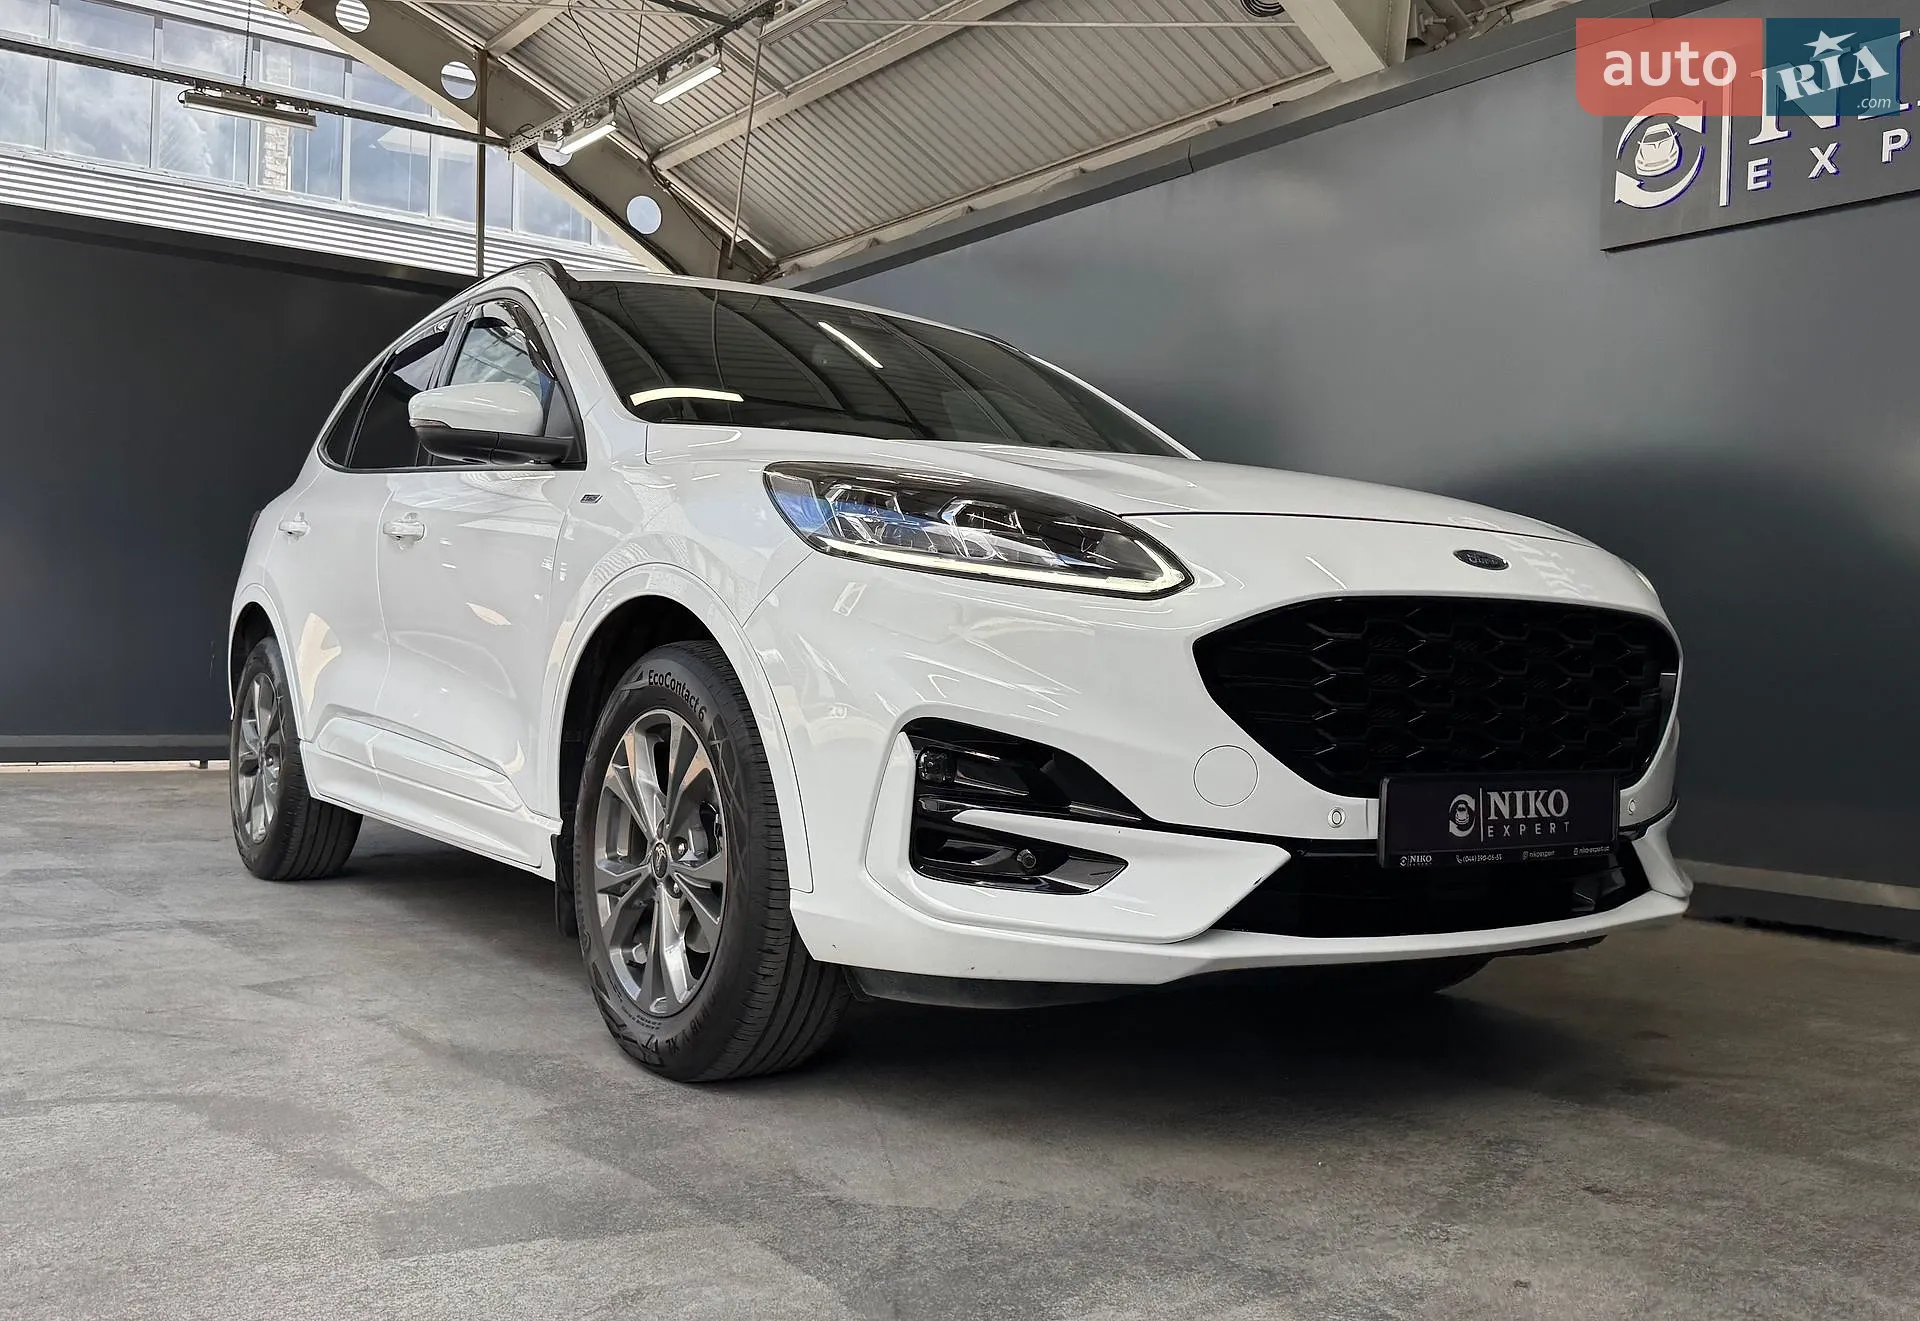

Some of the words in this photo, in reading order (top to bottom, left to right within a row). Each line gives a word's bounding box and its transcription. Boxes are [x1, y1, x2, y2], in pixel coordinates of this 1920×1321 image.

[1748, 28, 1920, 145] NI
[649, 669, 700, 713] EcoContact
[698, 705, 707, 722] 6
[1487, 789, 1569, 820] NIKO
[1487, 821, 1570, 838] EXPERT
